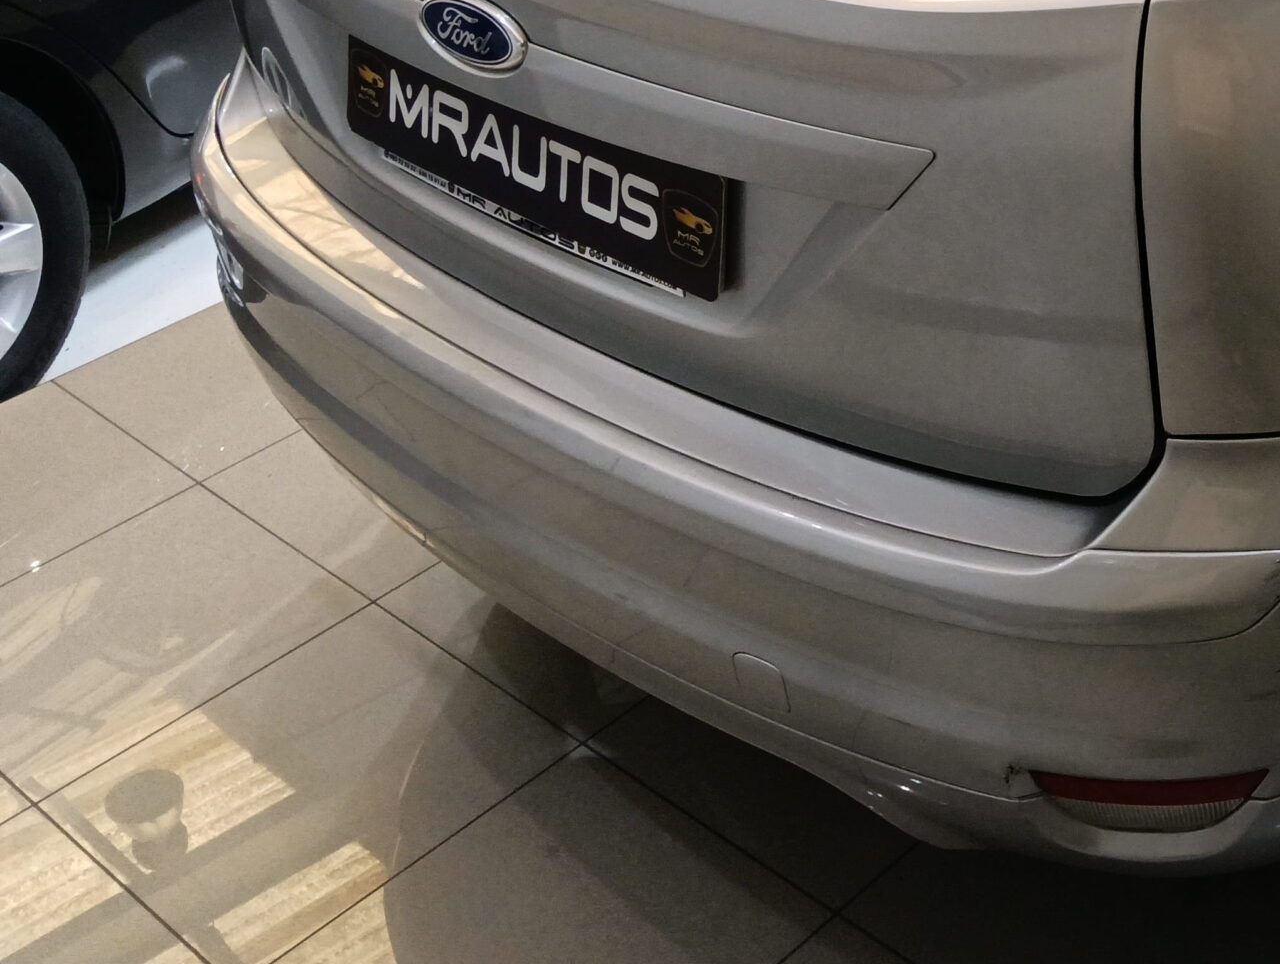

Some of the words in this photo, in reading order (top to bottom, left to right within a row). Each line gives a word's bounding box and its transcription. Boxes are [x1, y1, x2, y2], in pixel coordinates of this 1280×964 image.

[437, 7, 493, 56] Ford
[456, 185, 487, 210] MR
[673, 238, 705, 256] AUTOS
[678, 230, 701, 246] MR
